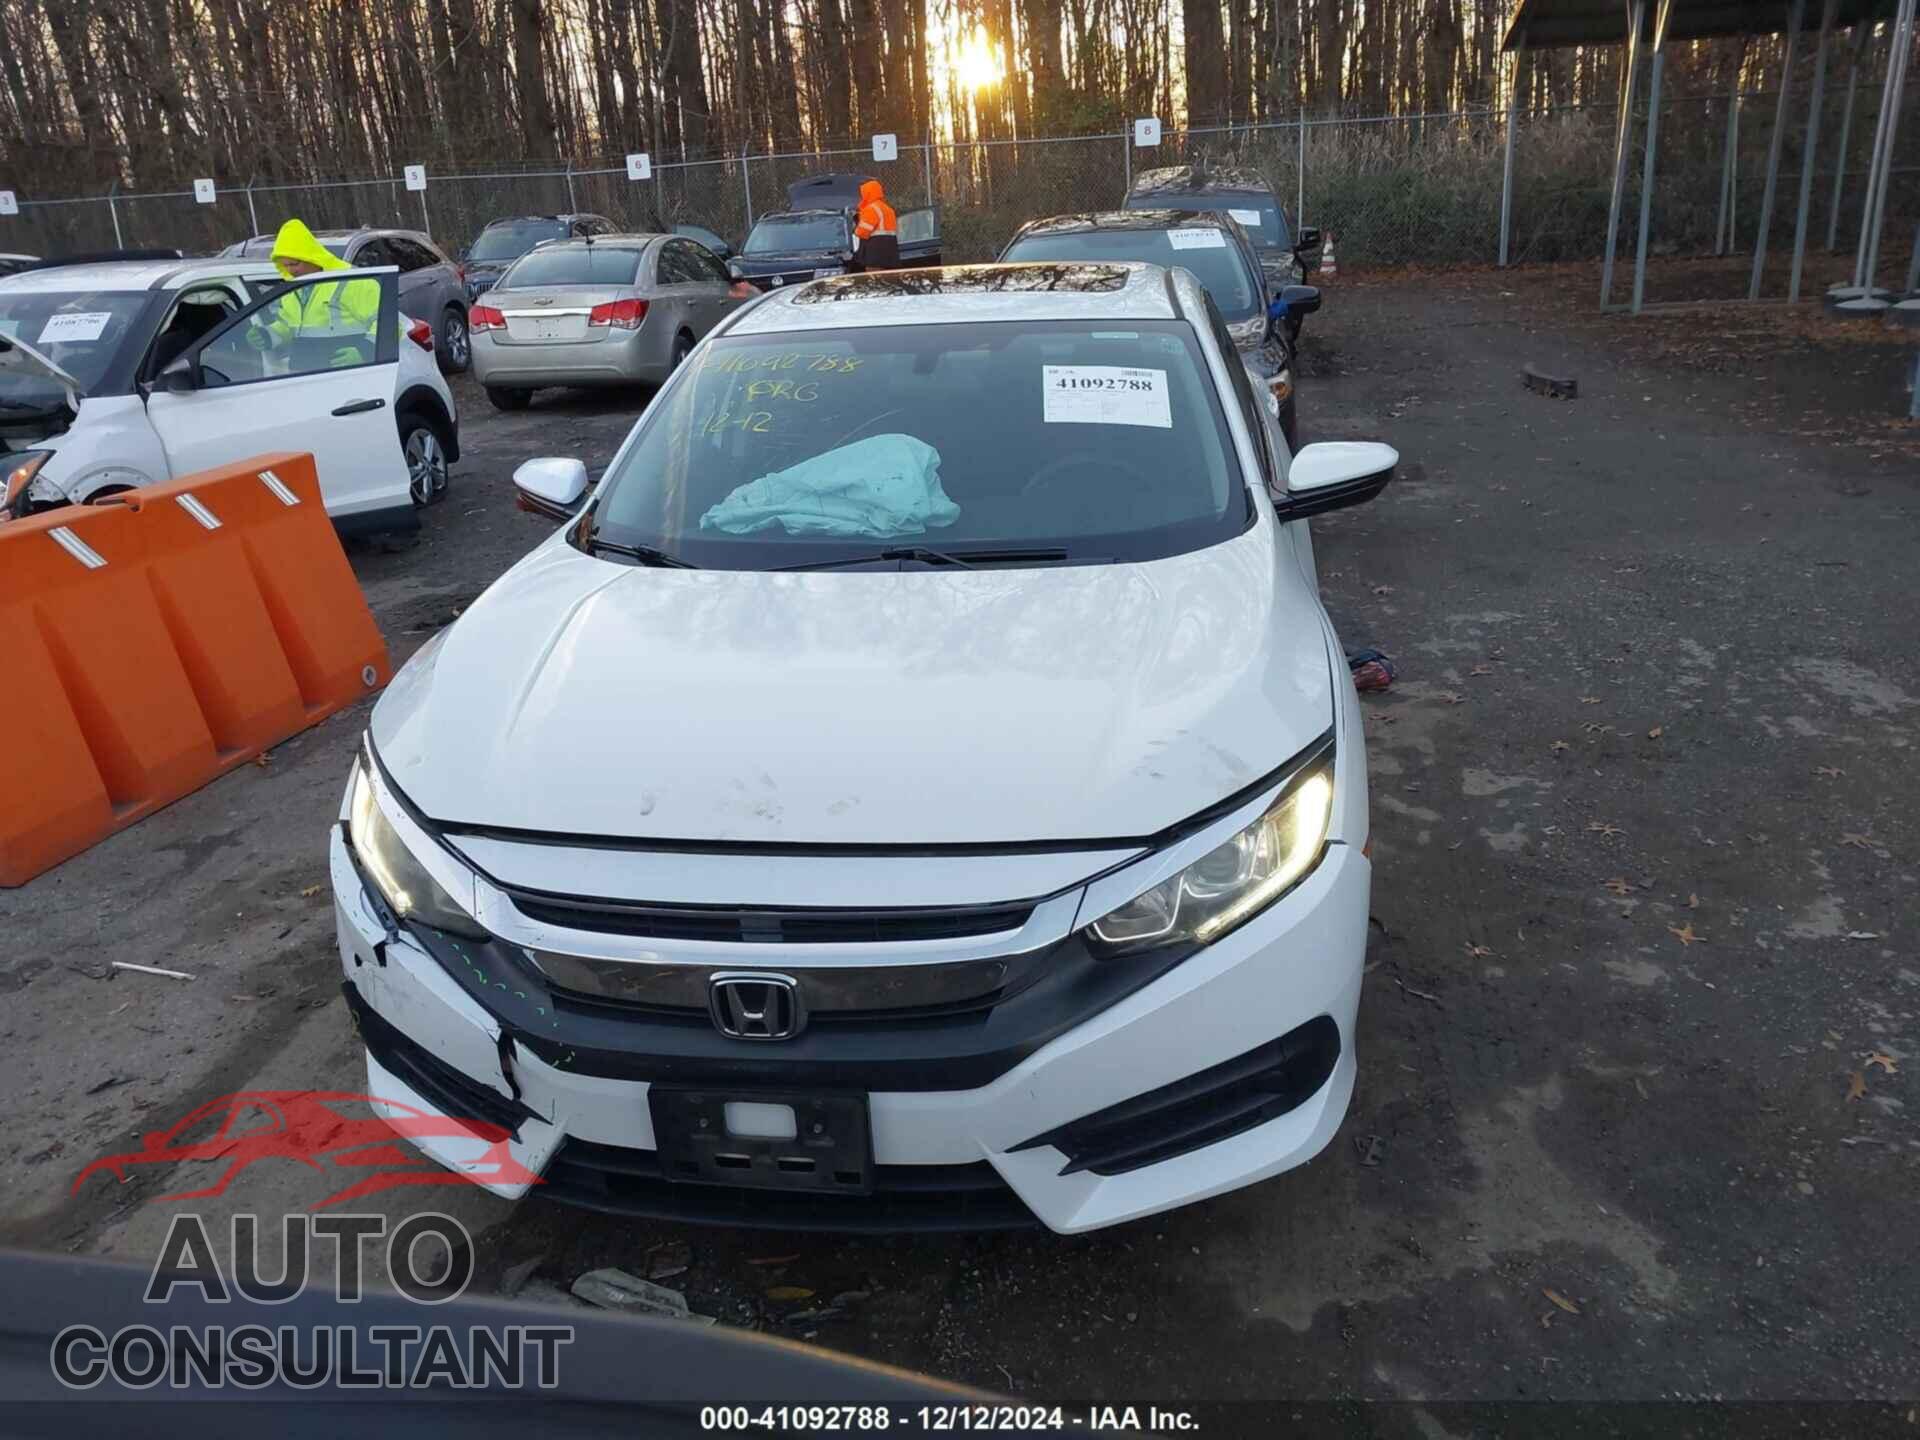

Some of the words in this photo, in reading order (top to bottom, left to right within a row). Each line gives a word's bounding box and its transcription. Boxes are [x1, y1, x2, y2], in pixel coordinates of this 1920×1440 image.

[1143, 125, 1152, 136] 8
[880, 140, 889, 151] 7
[634, 159, 643, 169] 6
[411, 171, 419, 181] 5
[1055, 378, 1153, 391] 41092788
